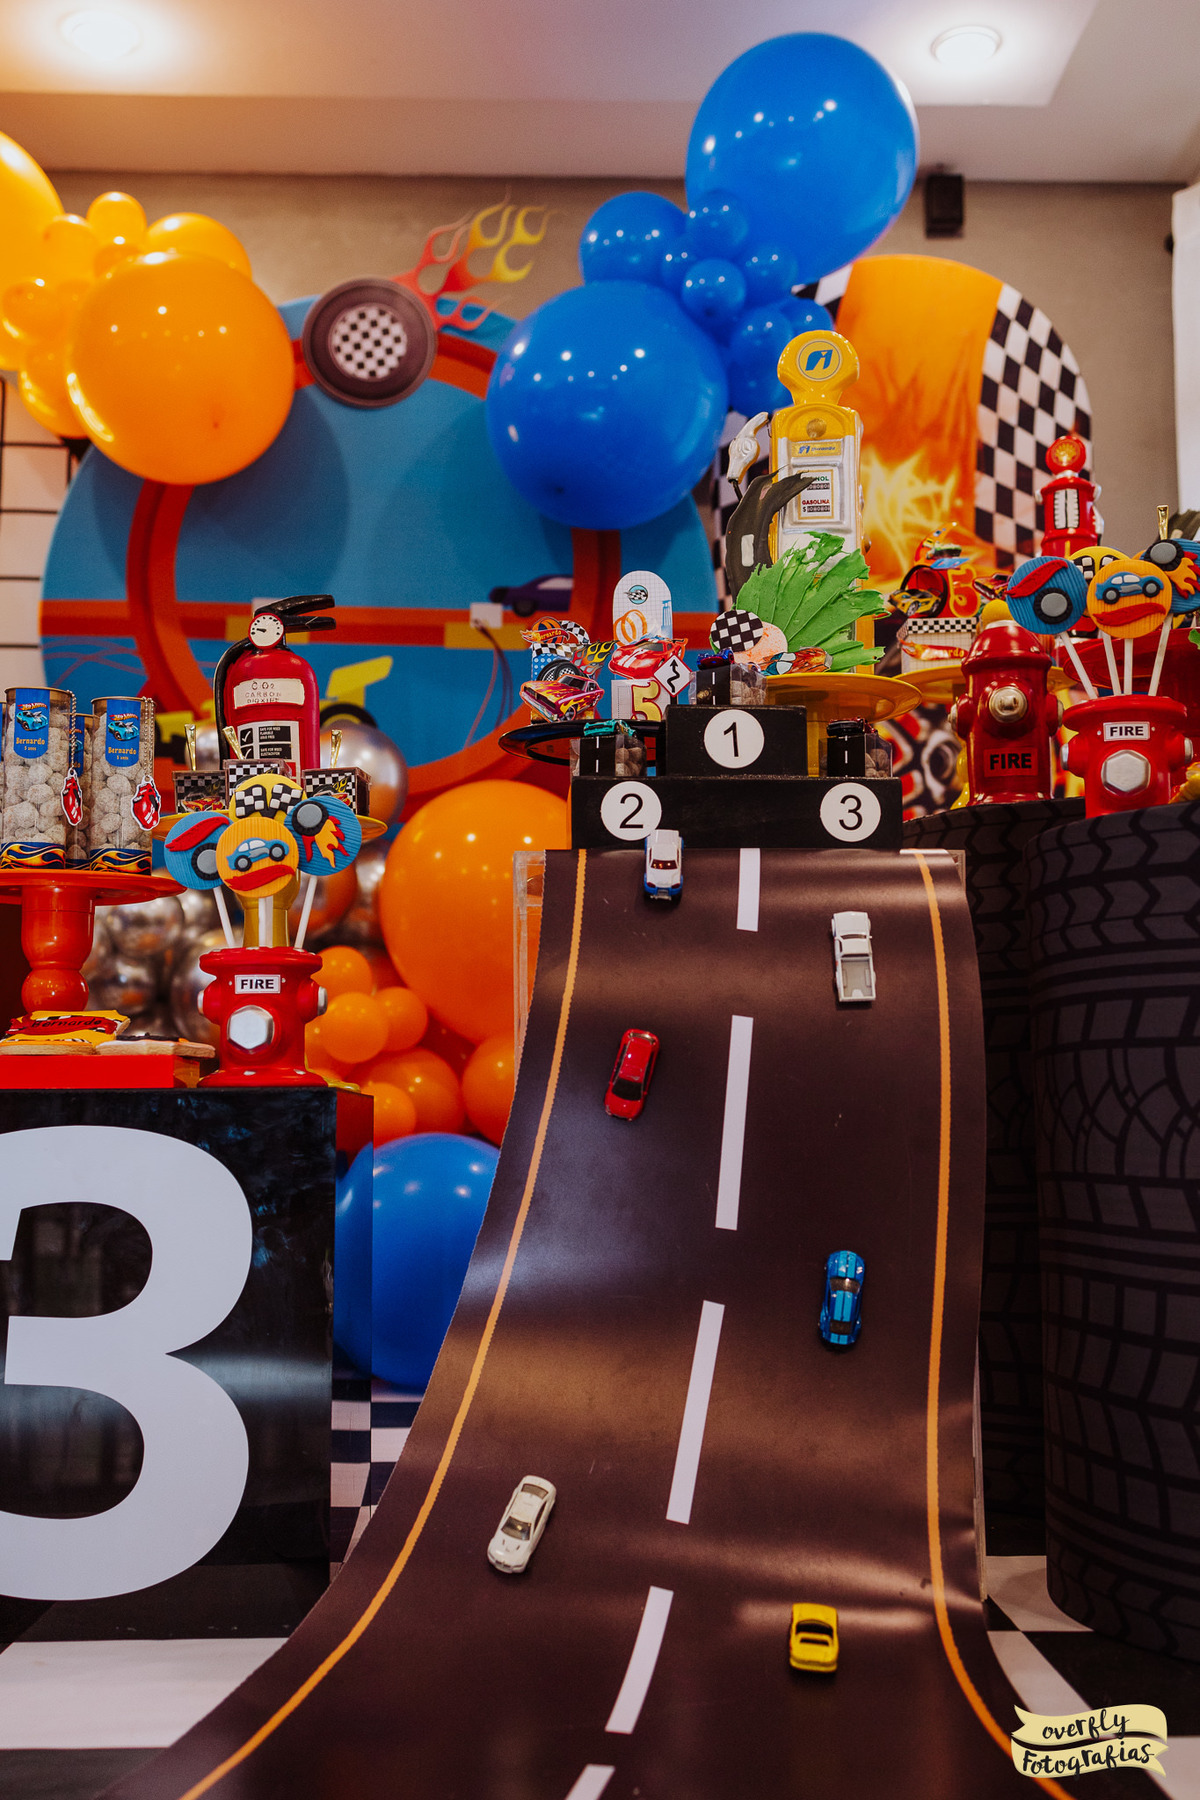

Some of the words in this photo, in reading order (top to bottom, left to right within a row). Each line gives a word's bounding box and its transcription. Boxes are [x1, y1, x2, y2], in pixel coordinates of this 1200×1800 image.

[947, 563, 981, 618] 5
[631, 679, 662, 721] 5
[16, 737, 46, 745] Bernardo
[723, 721, 739, 757] 1
[1110, 725, 1144, 737] FIRE
[107, 746, 137, 755] Bernardo
[989, 753, 1032, 770] FIRE
[619, 793, 644, 829] 2
[838, 795, 863, 831] 3
[241, 979, 274, 990] FIRE
[0, 1125, 253, 1601] 3
